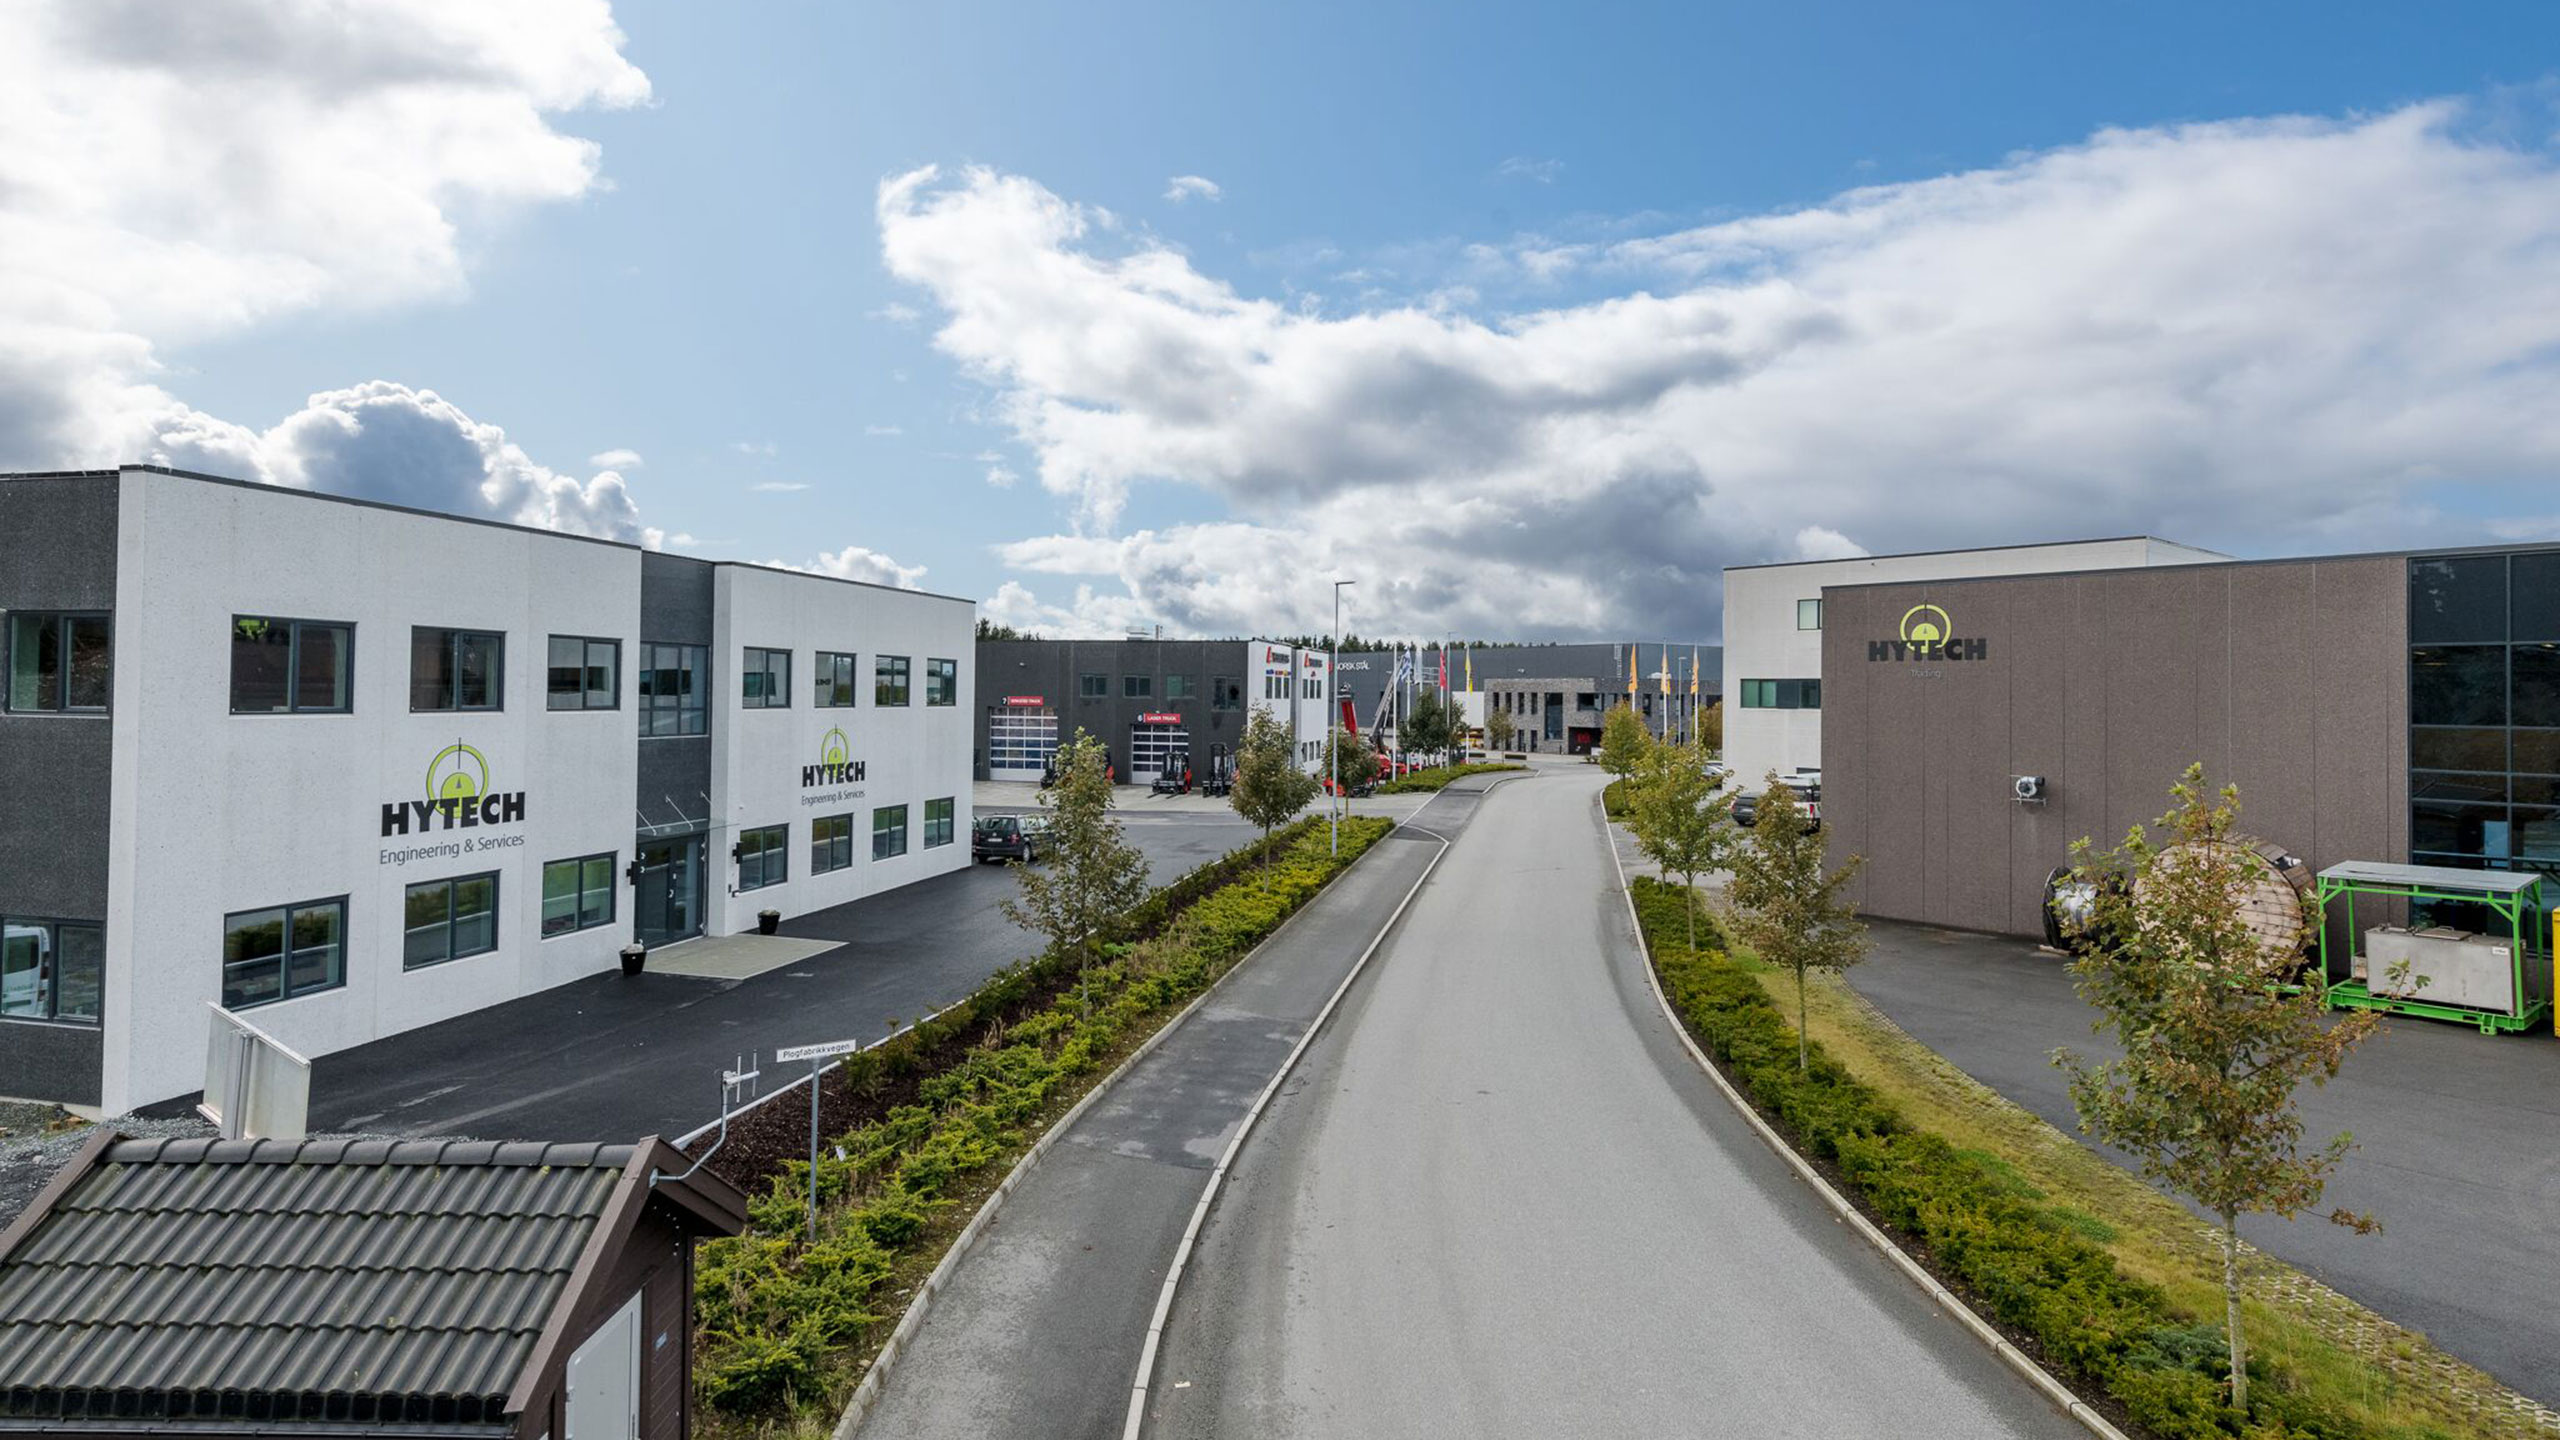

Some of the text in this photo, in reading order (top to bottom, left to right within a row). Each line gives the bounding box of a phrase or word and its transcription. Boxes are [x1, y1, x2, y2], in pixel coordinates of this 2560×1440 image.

[1868, 638, 1986, 662] HYTECH
[1337, 662, 1355, 671] ORSK
[1911, 669, 1941, 678] Trading
[802, 760, 866, 788] HYTECH
[801, 793, 837, 807] Engineering
[843, 789, 866, 800] Services
[381, 792, 526, 838] HYTECH
[380, 834, 525, 866] Engineering & Services
[783, 1042, 850, 1058] Plogfabrikkvegen
